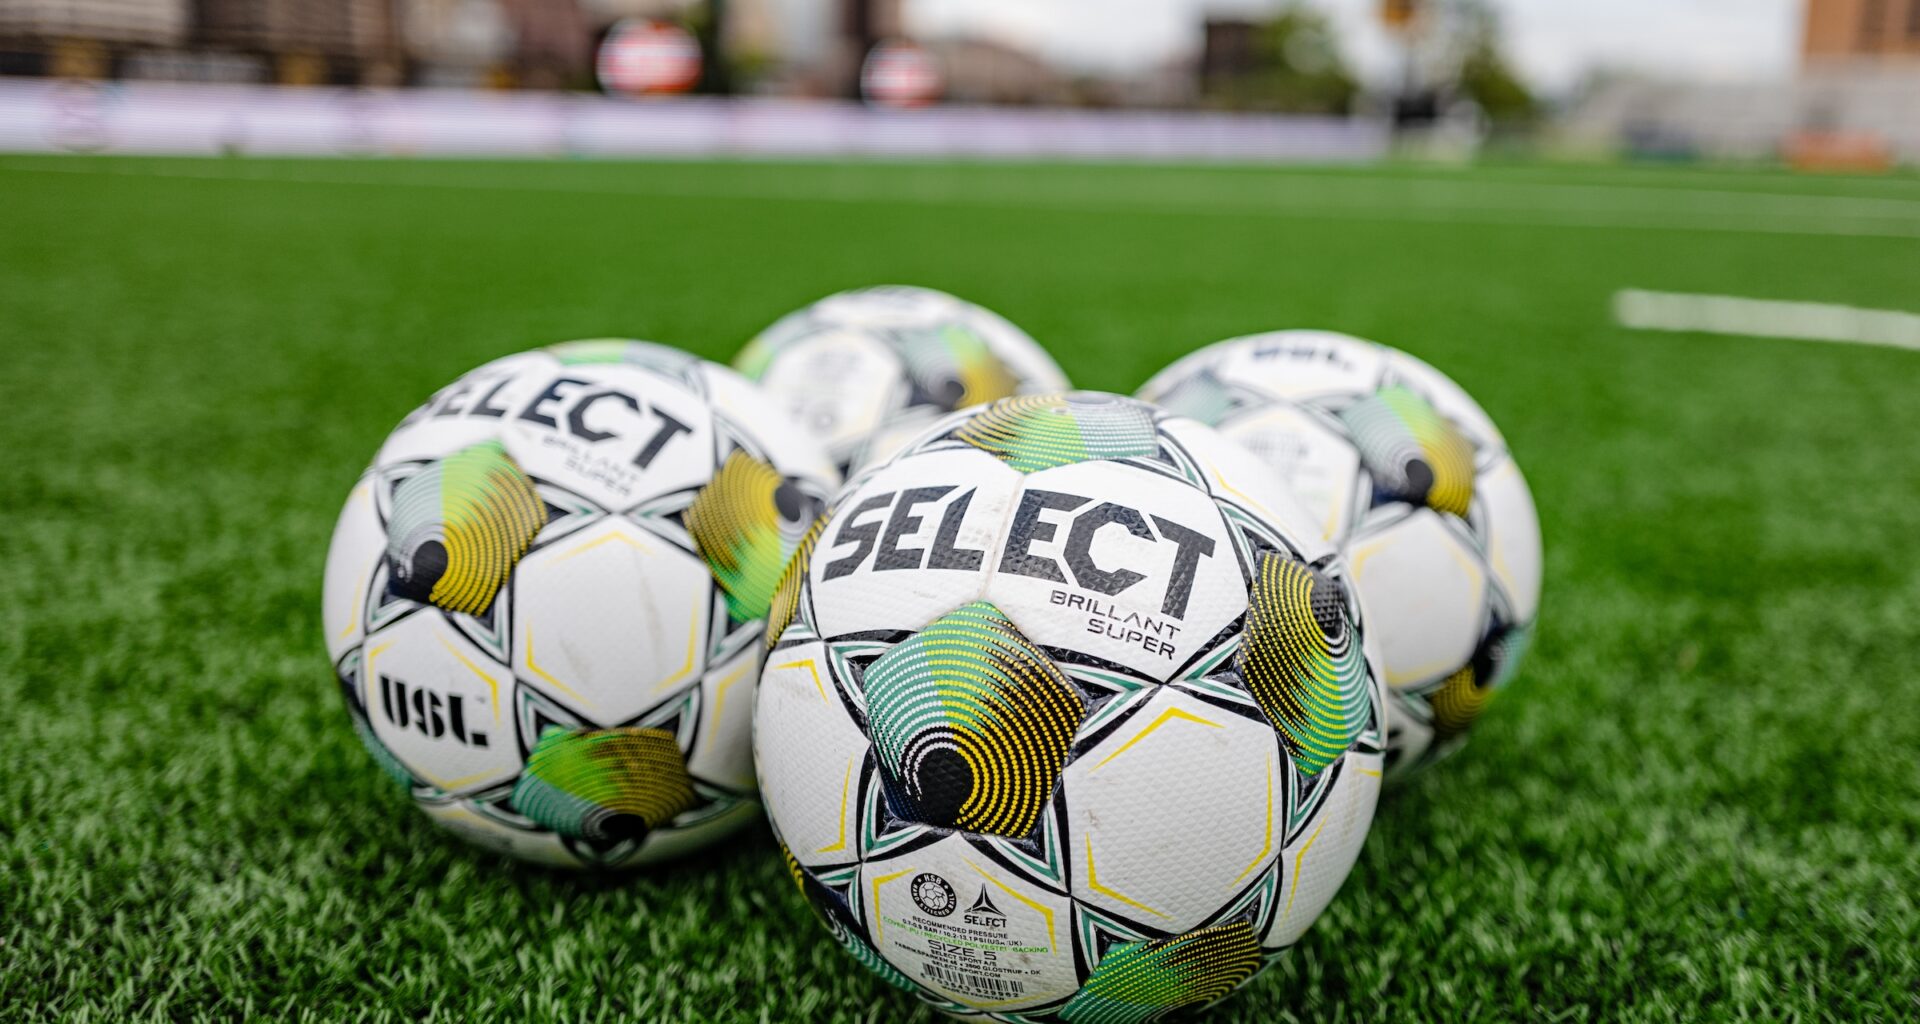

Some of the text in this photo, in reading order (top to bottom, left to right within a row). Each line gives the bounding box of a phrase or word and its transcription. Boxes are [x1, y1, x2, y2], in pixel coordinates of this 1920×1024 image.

[821, 485, 1216, 622] SELECT
[1050, 589, 1181, 640] BRILLANT
[1087, 618, 1176, 661] SUPER
[924, 874, 942, 885] HSB
[912, 916, 1008, 939] RECOMMENDED PRESSURE
[924, 925, 938, 934] BAR
[964, 914, 1007, 928] SELECT
[928, 939, 997, 961] SIZE 5
[930, 949, 957, 960] SELECT
[958, 955, 982, 965] SPORT
